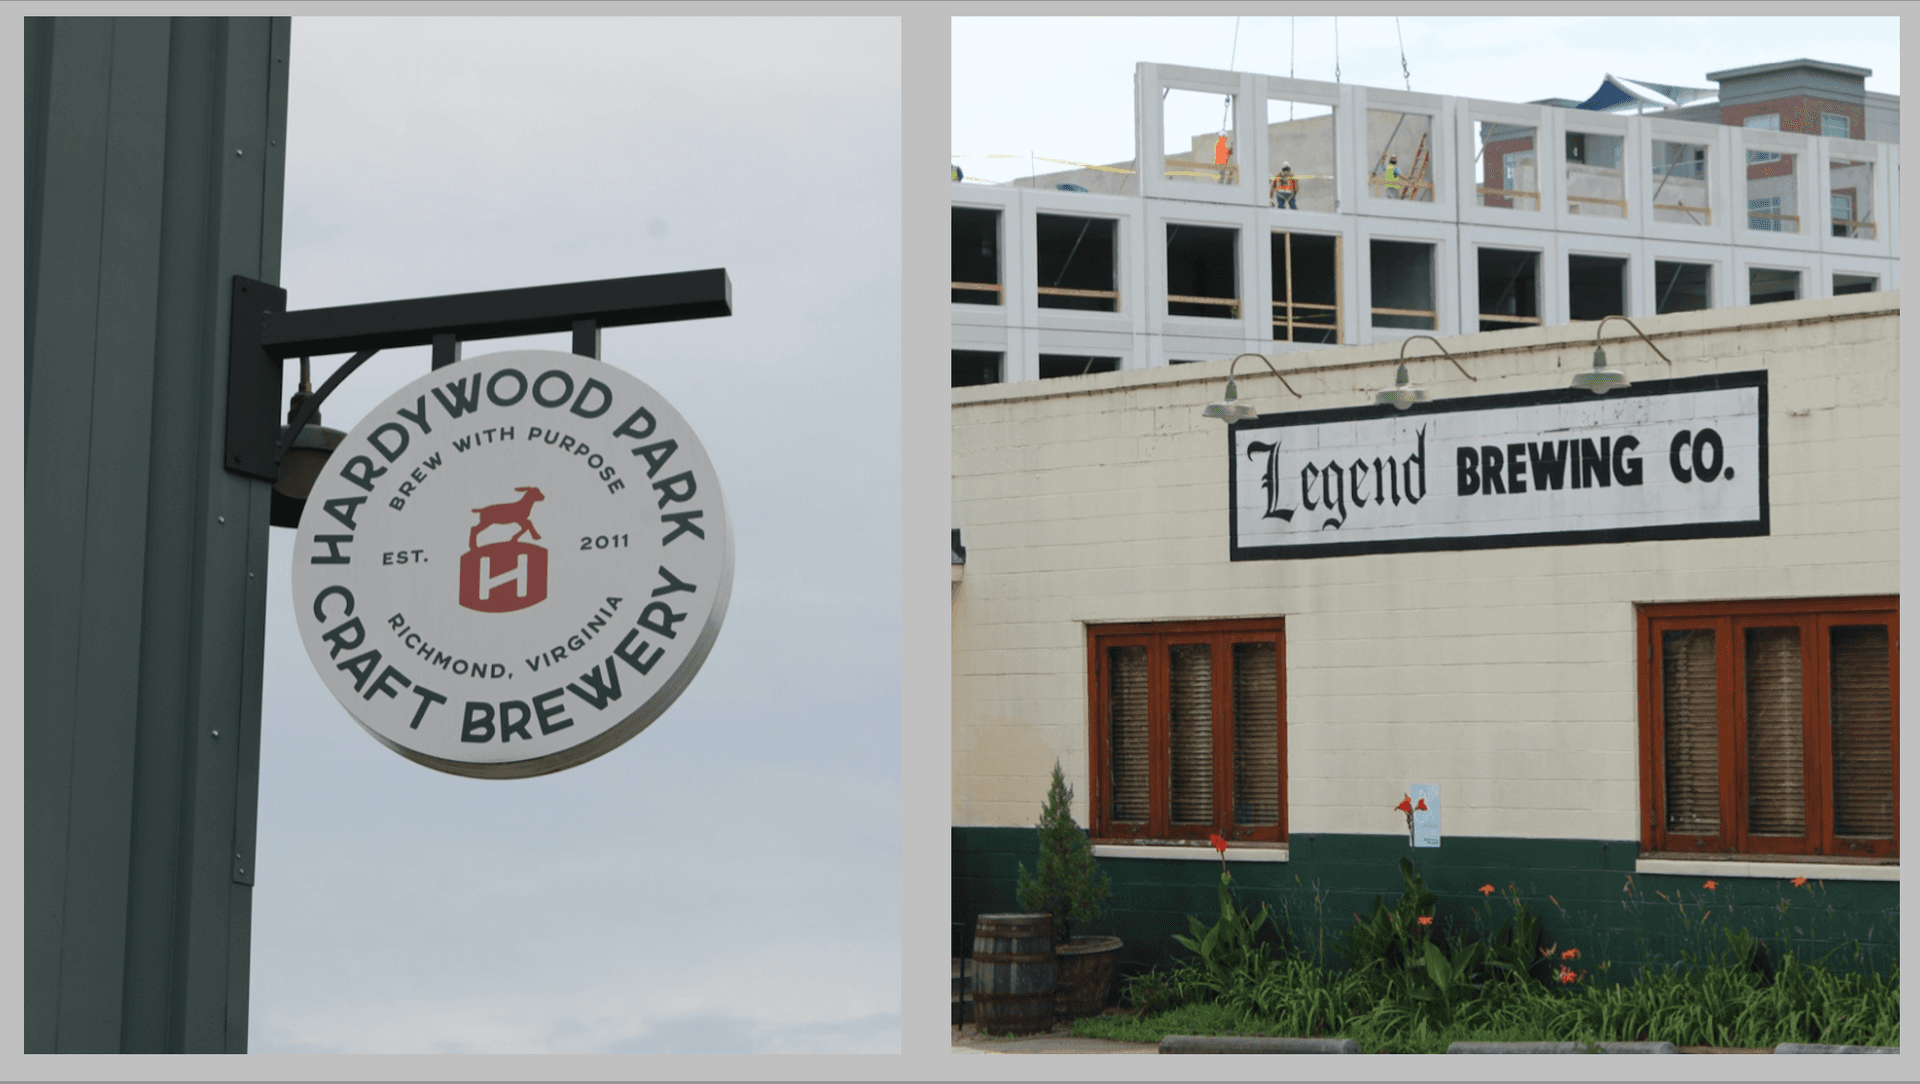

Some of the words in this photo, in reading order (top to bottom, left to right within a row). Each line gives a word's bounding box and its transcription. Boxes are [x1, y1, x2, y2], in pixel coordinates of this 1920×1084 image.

[311, 368, 613, 565] HARDYWOOD
[612, 406, 705, 547] PARK
[389, 451, 443, 511] BREW
[453, 426, 515, 454] WITH
[528, 427, 625, 495] PURPOSE
[1247, 422, 1427, 530] Legend
[1457, 435, 1643, 497] BREWING
[1669, 428, 1735, 484] CO.
[382, 550, 429, 566] EST.
[580, 533, 629, 551] 2011
[313, 585, 447, 730] CRAFT
[460, 565, 698, 743] BREWERY
[387, 613, 514, 680] RICHMOND,
[526, 595, 624, 673] VIRGINIA
